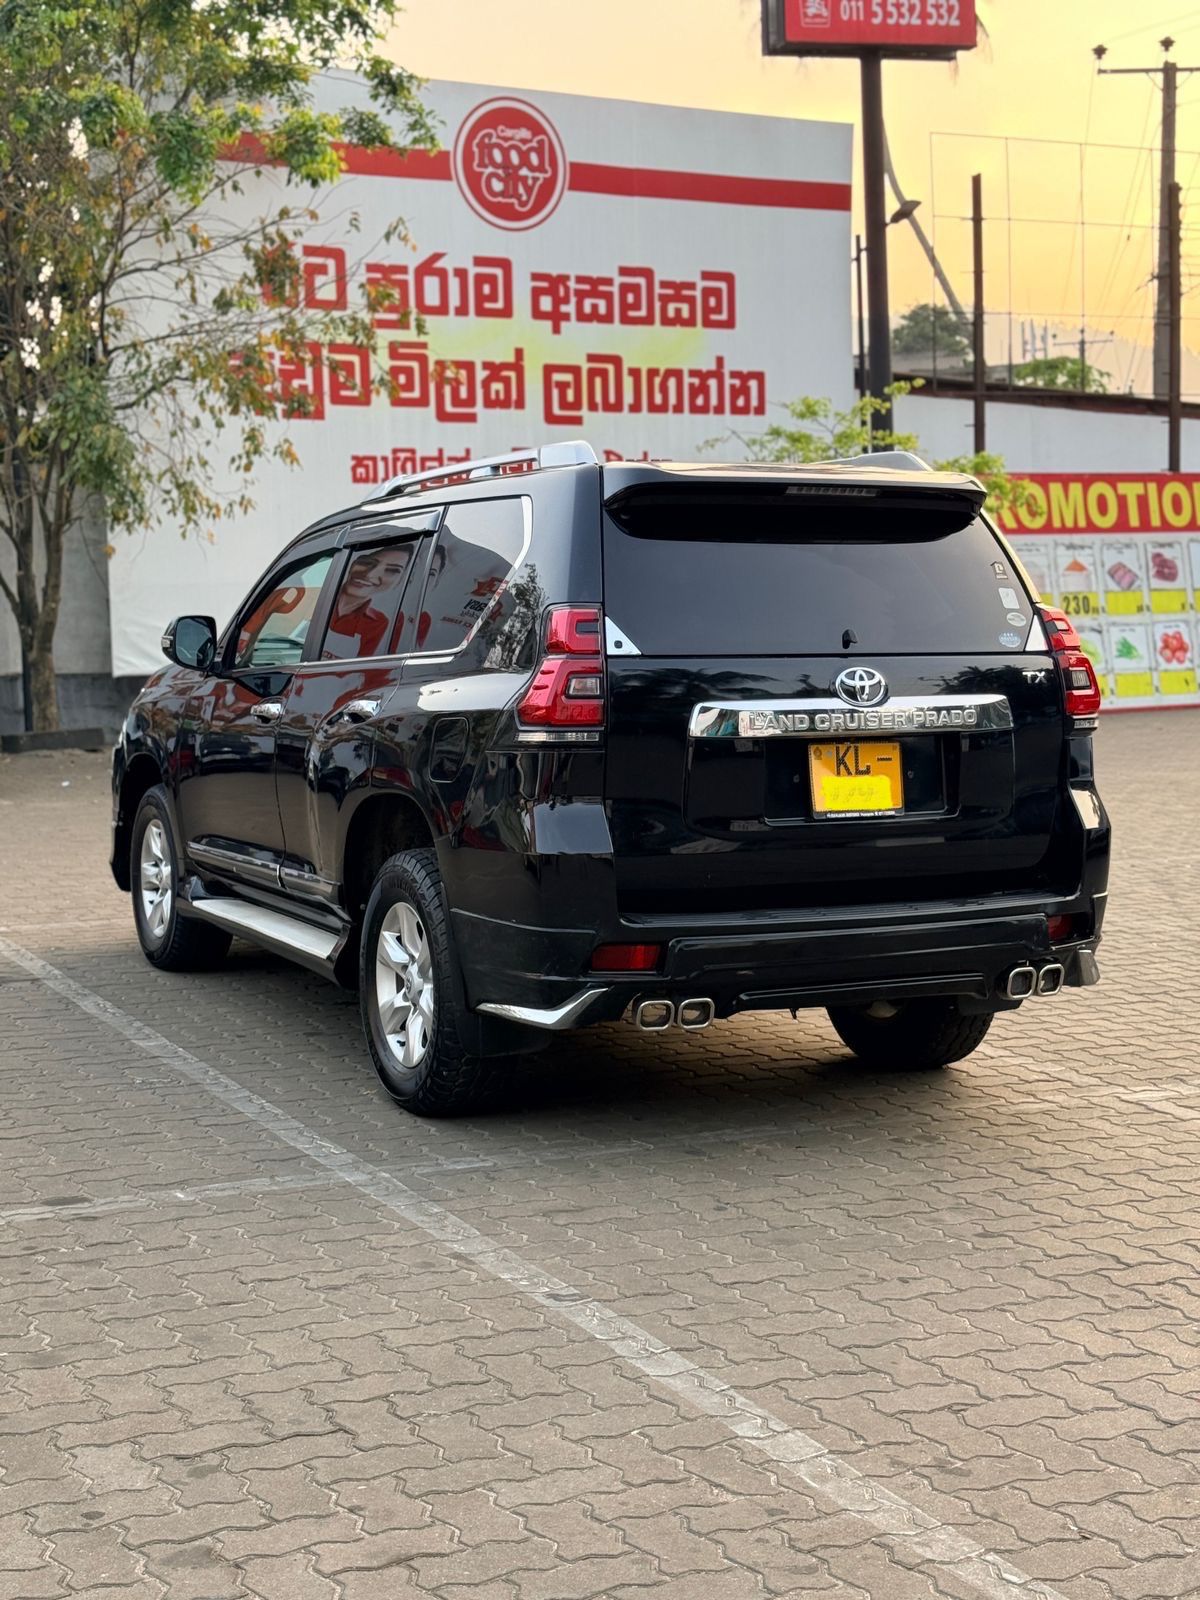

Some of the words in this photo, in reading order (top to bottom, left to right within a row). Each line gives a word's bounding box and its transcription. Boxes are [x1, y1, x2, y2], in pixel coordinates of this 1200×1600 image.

[840, 0, 865, 21] 011
[531, 267, 736, 334] අසමසම
[544, 354, 765, 425] ලබාගන්න
[994, 481, 1200, 529] OMOTIO
[1063, 595, 1090, 615] 230
[1022, 671, 1047, 684] TX
[750, 712, 809, 732] LAND
[814, 710, 906, 731] CRUISER
[911, 708, 978, 728] PRADO
